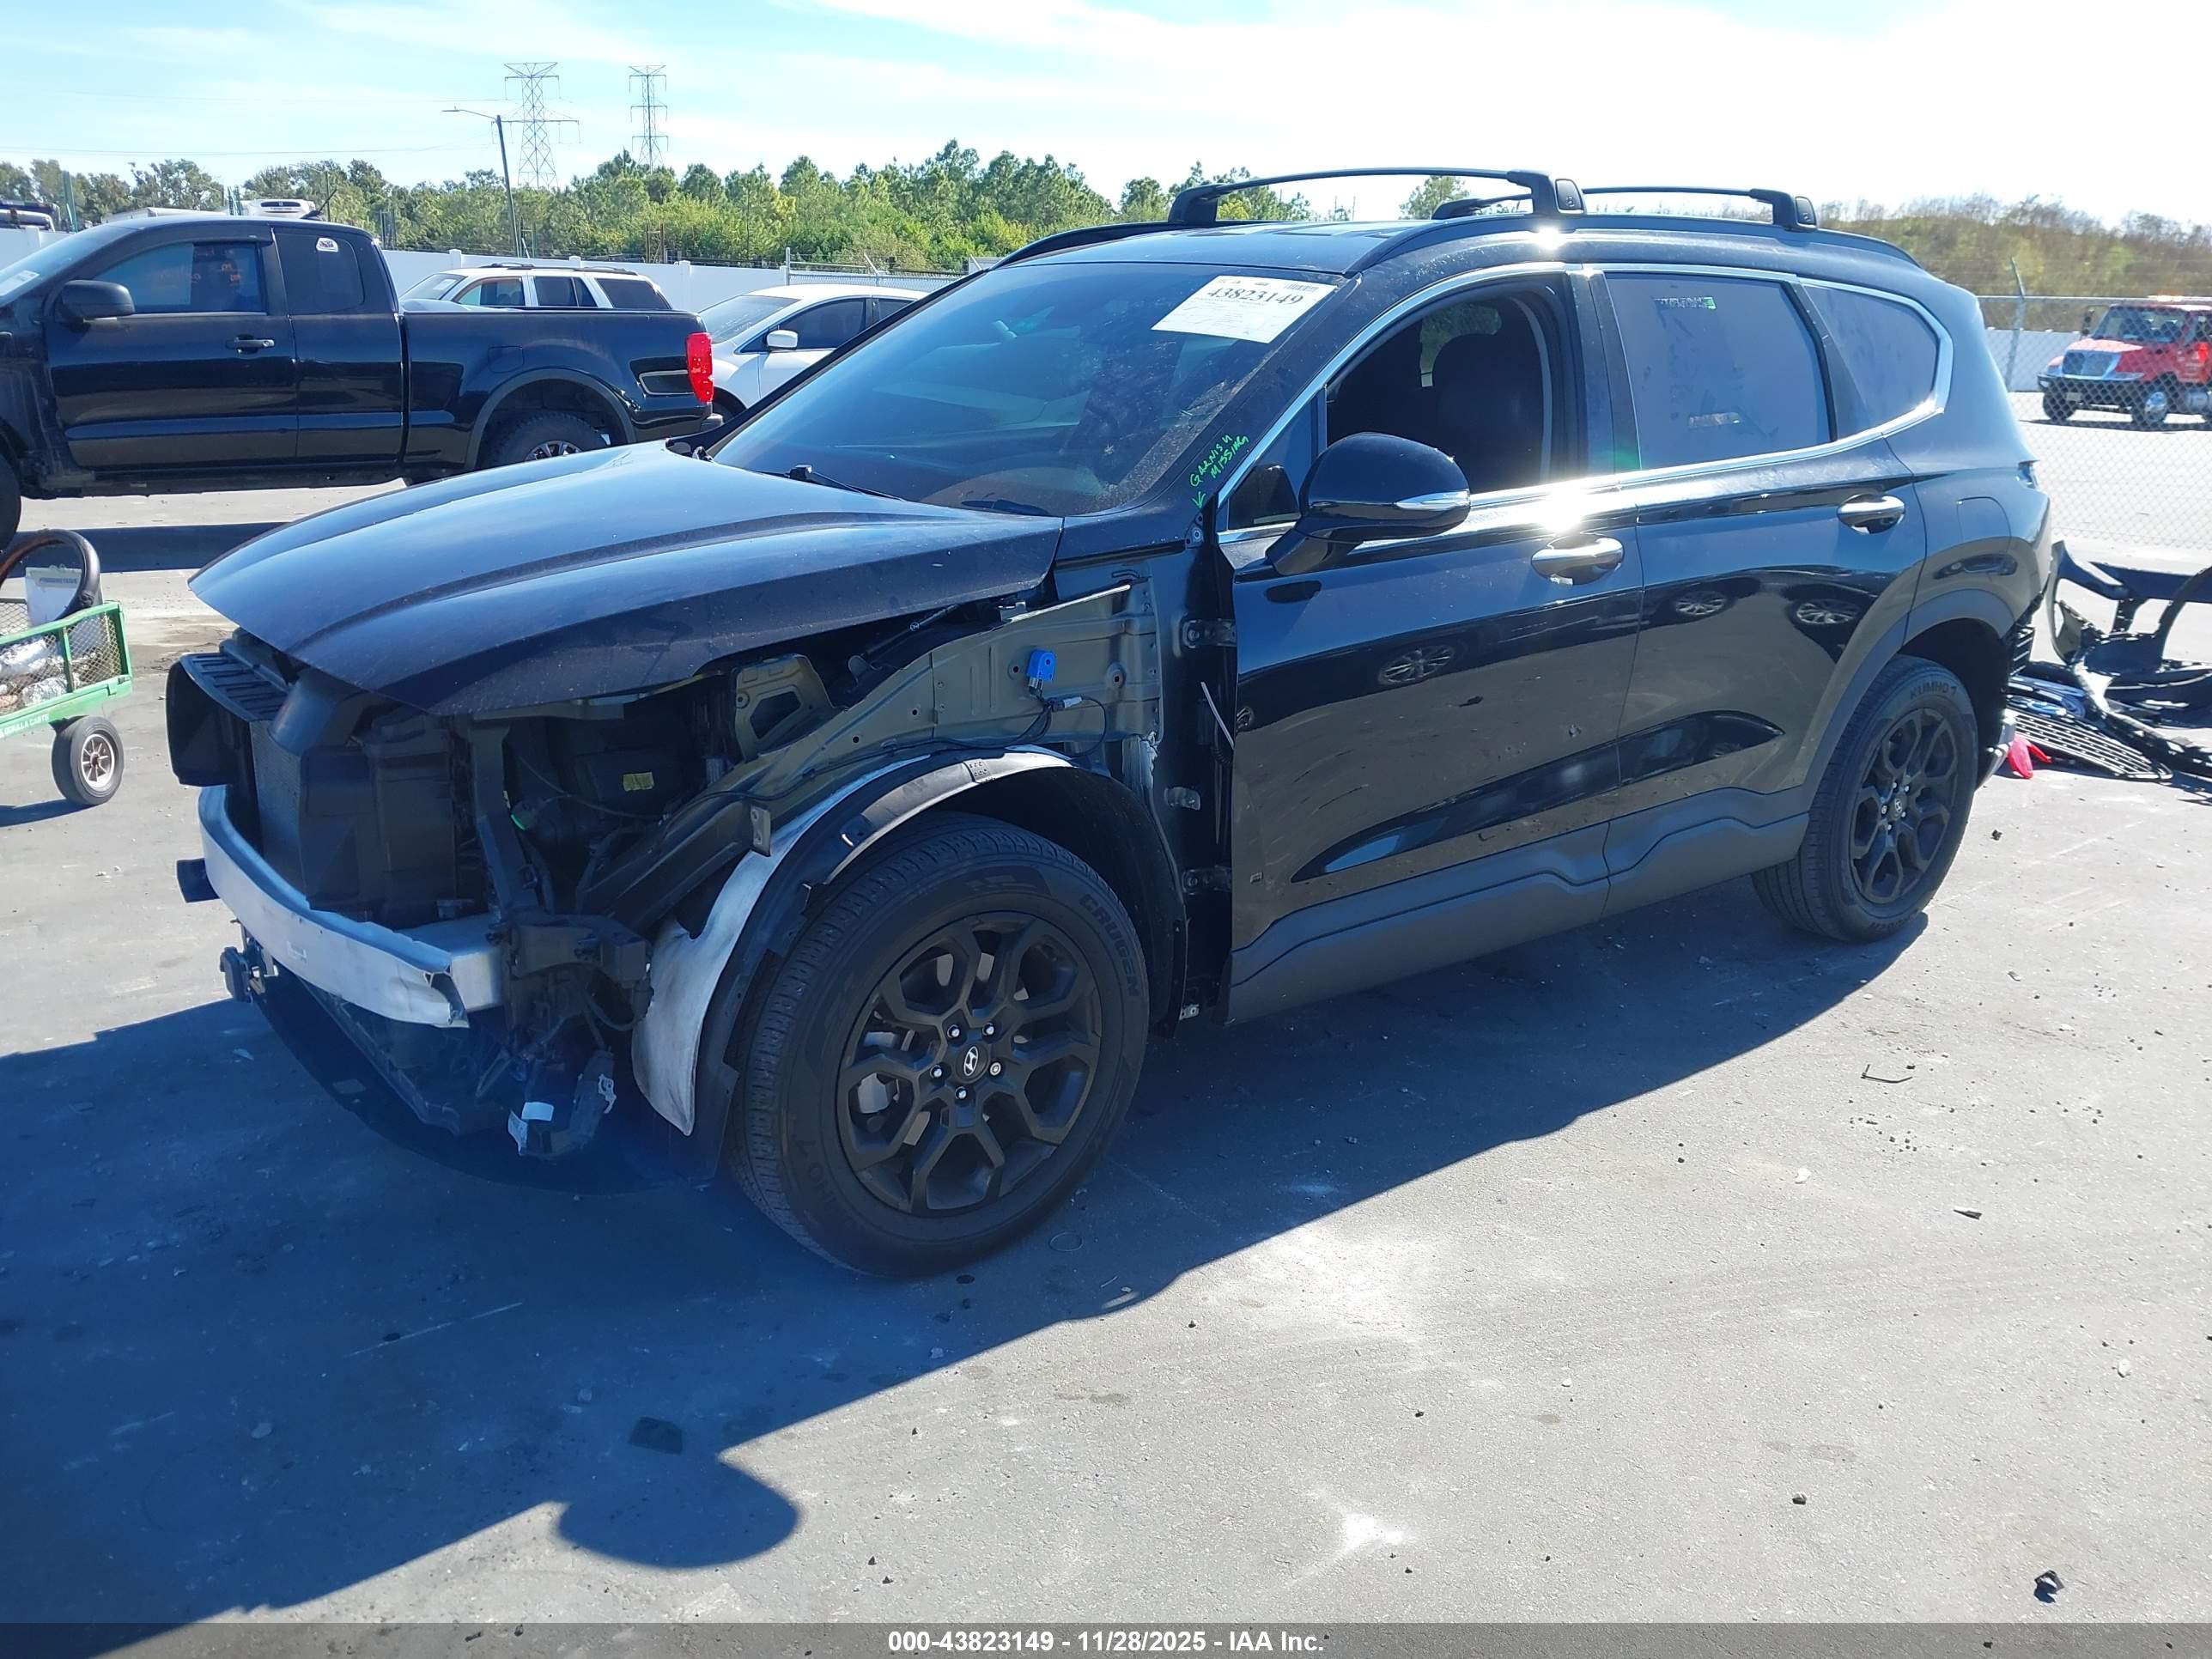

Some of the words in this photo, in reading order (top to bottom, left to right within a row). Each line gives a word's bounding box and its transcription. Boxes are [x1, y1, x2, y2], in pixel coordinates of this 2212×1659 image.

[1207, 287, 1304, 305] 43823149
[1210, 435, 1249, 478] MISSING
[1079, 893, 1141, 996] CRUGEN
